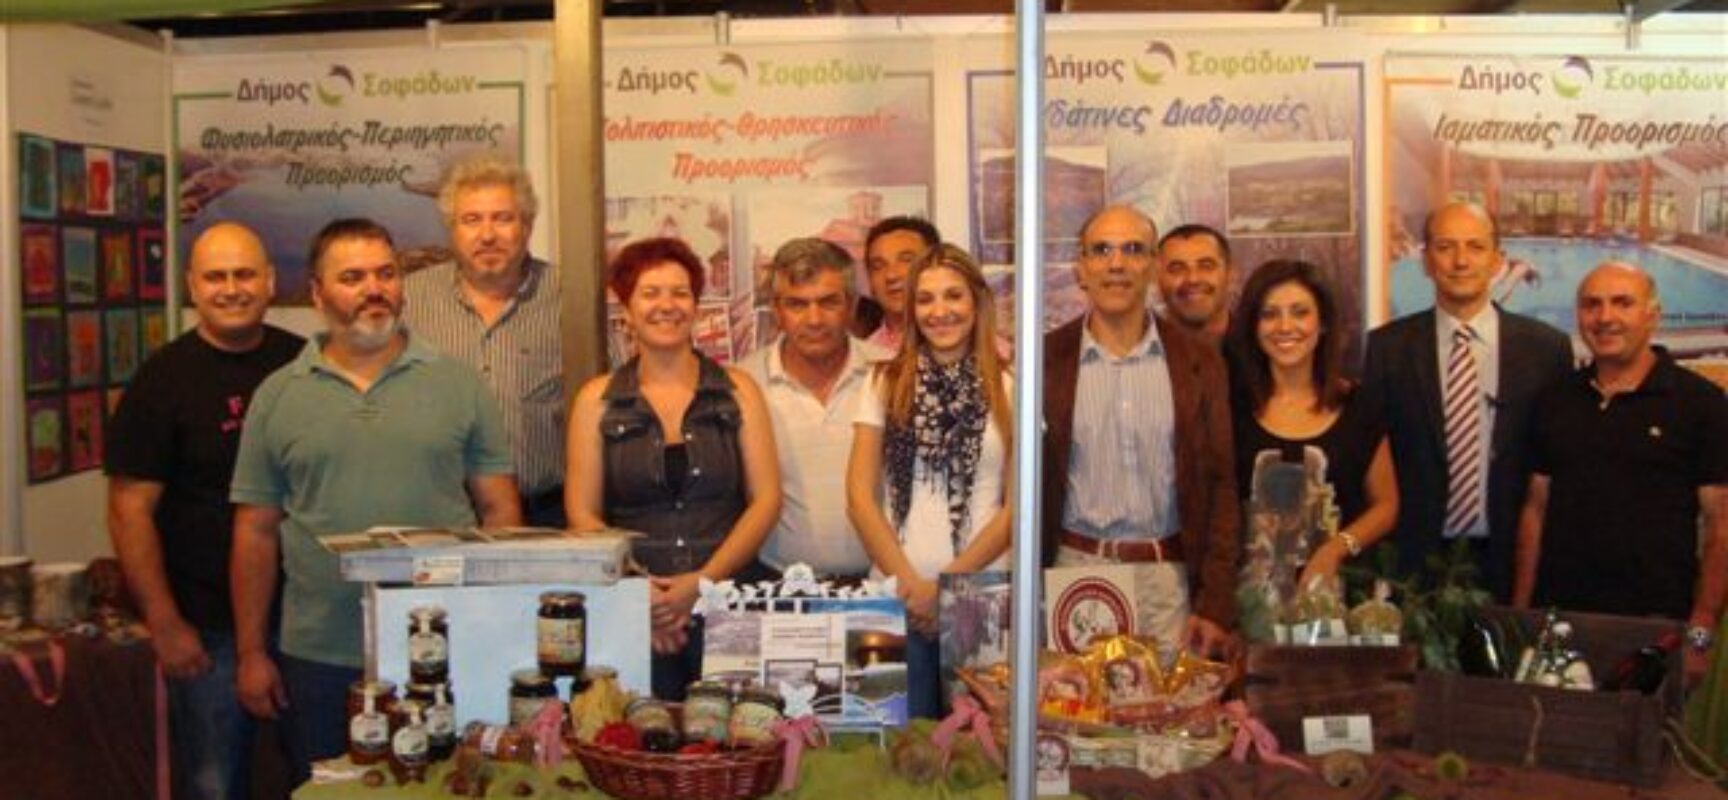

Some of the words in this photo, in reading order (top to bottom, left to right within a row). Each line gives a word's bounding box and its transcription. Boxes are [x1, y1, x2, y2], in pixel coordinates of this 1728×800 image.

[617, 65, 698, 94] Δήμος
[756, 58, 883, 89] Σοφάδων
[1186, 49, 1311, 80] Σοφάδων
[1459, 64, 1544, 95] Δήμος
[1603, 66, 1728, 97] Σοφάδων
[236, 78, 311, 106] Δήμος
[362, 70, 477, 102] Σοφάδων
[1162, 94, 1310, 136] Διαδρομές
[1432, 113, 1561, 150] Ιαματικός
[285, 157, 412, 190] Προορισμός
[671, 150, 818, 184] Προορισμός
